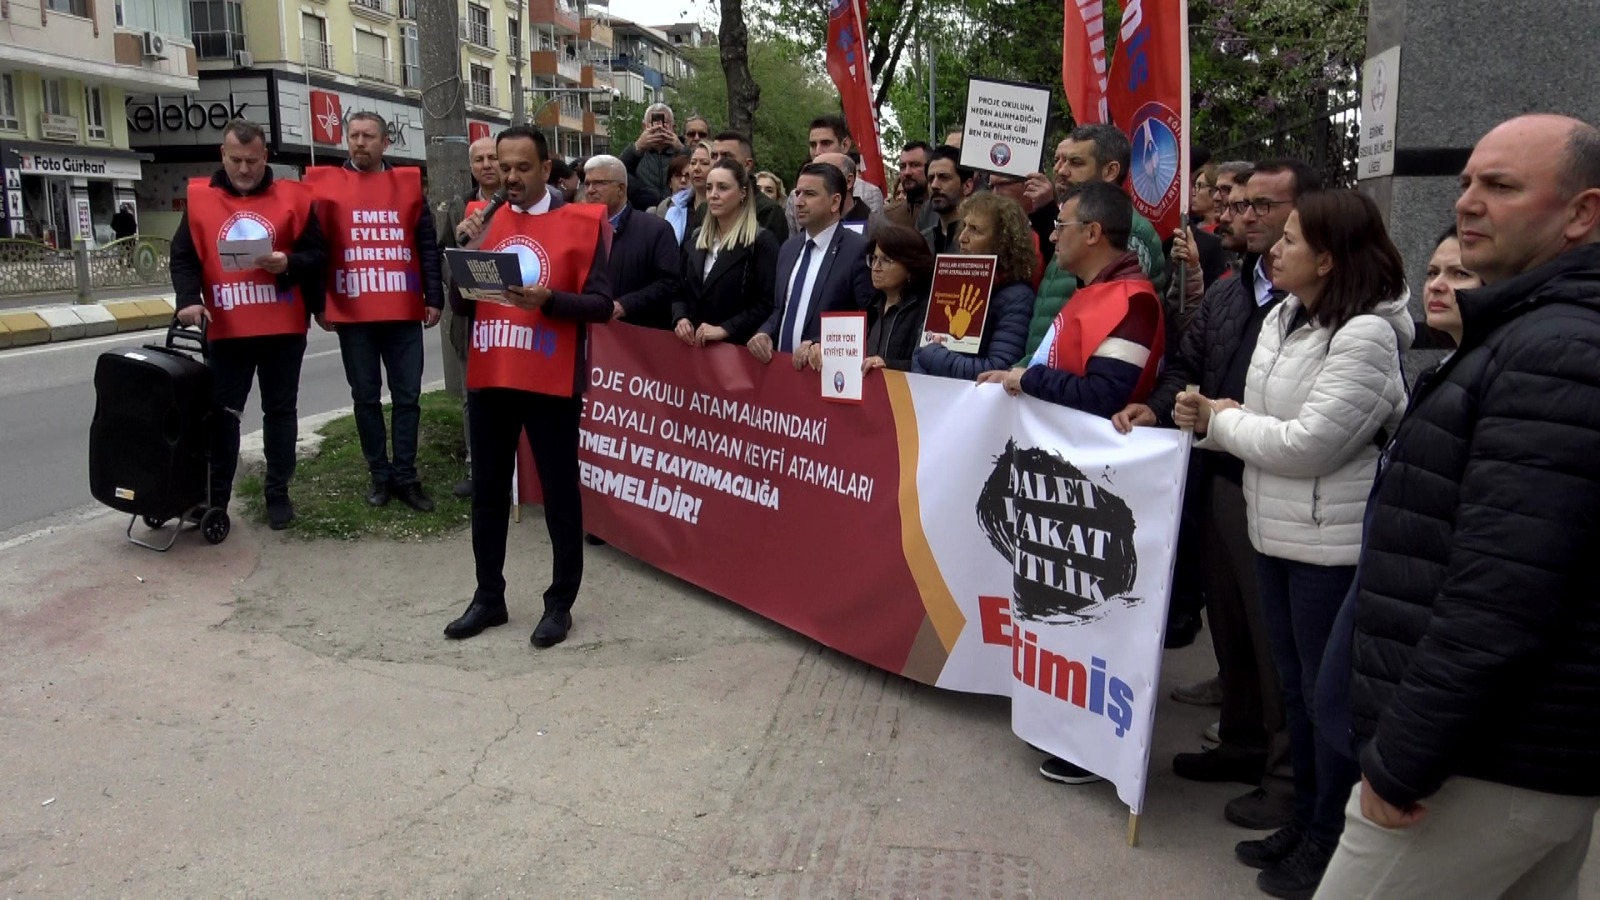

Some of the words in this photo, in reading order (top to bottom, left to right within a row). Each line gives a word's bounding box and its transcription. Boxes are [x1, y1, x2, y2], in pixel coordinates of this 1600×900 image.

[971, 107, 993, 117] NEDEN
[978, 96, 1000, 107] PROJE
[1001, 100, 1034, 112] OKULUNA
[968, 128, 981, 136] BEN
[983, 131, 991, 139] DE
[980, 119, 1012, 131] BAKANLIK
[34, 155, 61, 171] Foto
[62, 158, 105, 174] Gürkan
[352, 210, 400, 224] EMEK
[350, 228, 404, 241] EYLEM
[344, 245, 412, 263] DİRENİŞ
[629, 376, 684, 408] OKULU
[689, 392, 827, 445] ATAMALARINDAKİ
[591, 401, 656, 436] DAYALI
[660, 419, 742, 461] OLMAYAN
[744, 442, 785, 474] KEYFİ
[787, 455, 874, 502] ATAMALARI
[630, 443, 655, 468] VE
[655, 451, 779, 510] KAYIRMACILIĞA
[578, 460, 703, 524] ERMELİDİR!
